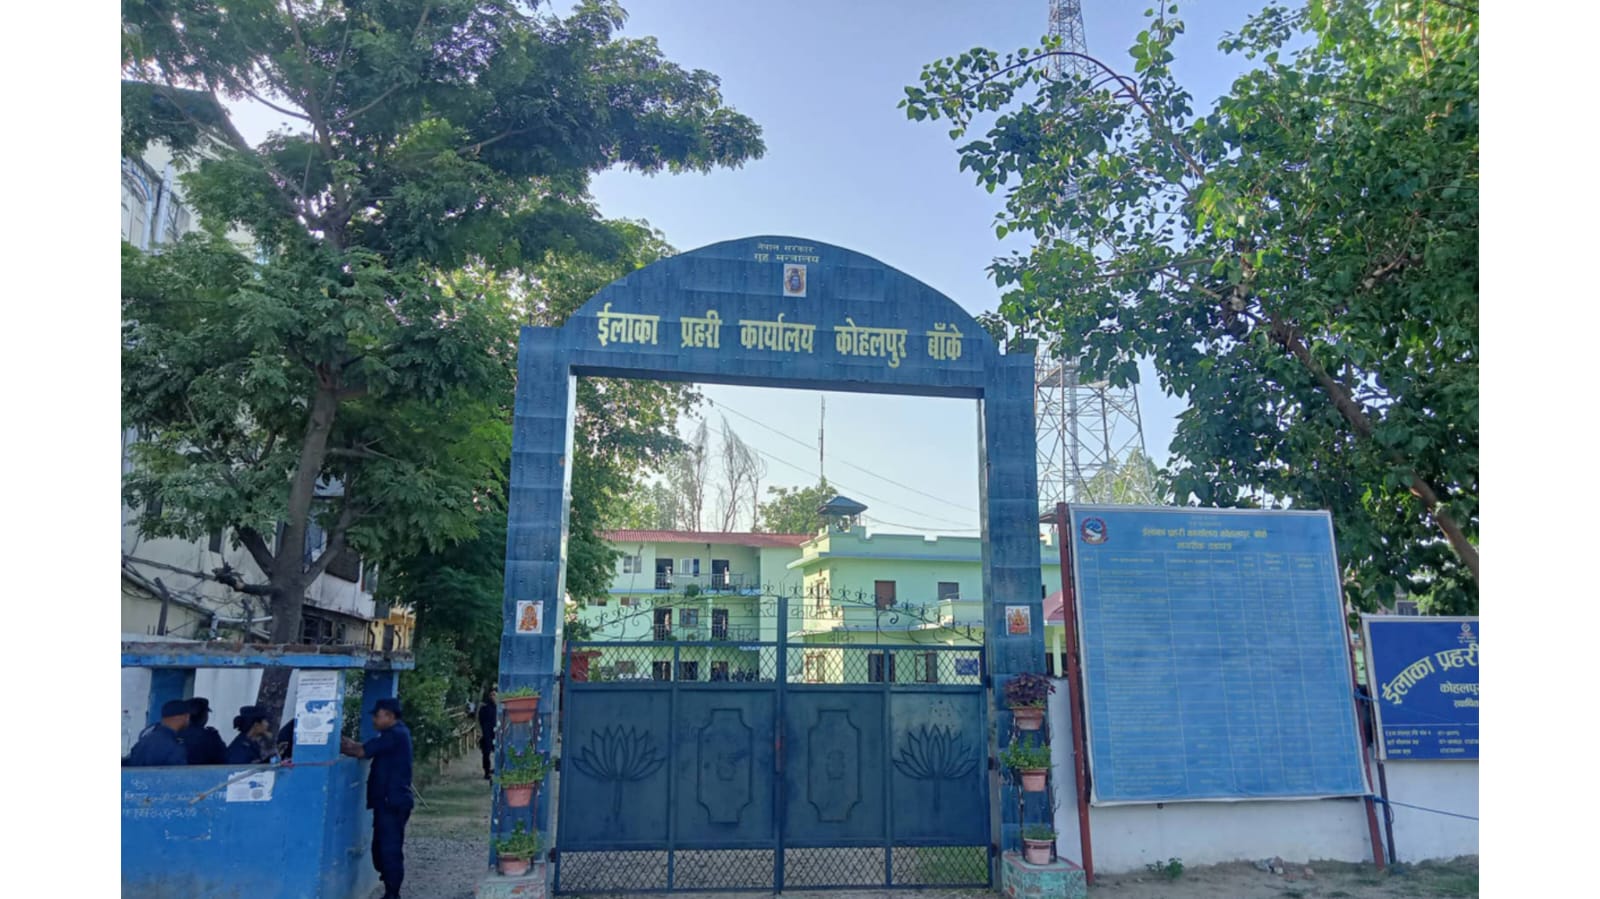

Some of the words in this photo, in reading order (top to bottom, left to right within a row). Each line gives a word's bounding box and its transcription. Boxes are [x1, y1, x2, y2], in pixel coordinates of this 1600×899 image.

[596, 302, 660, 347] ईलाका
[680, 310, 723, 349] प्रहरी
[739, 313, 817, 353] कार्यालय
[834, 317, 908, 368] कोहलपुर
[927, 322, 964, 361] बाँके
[1382, 656, 1436, 705] ईलाका
